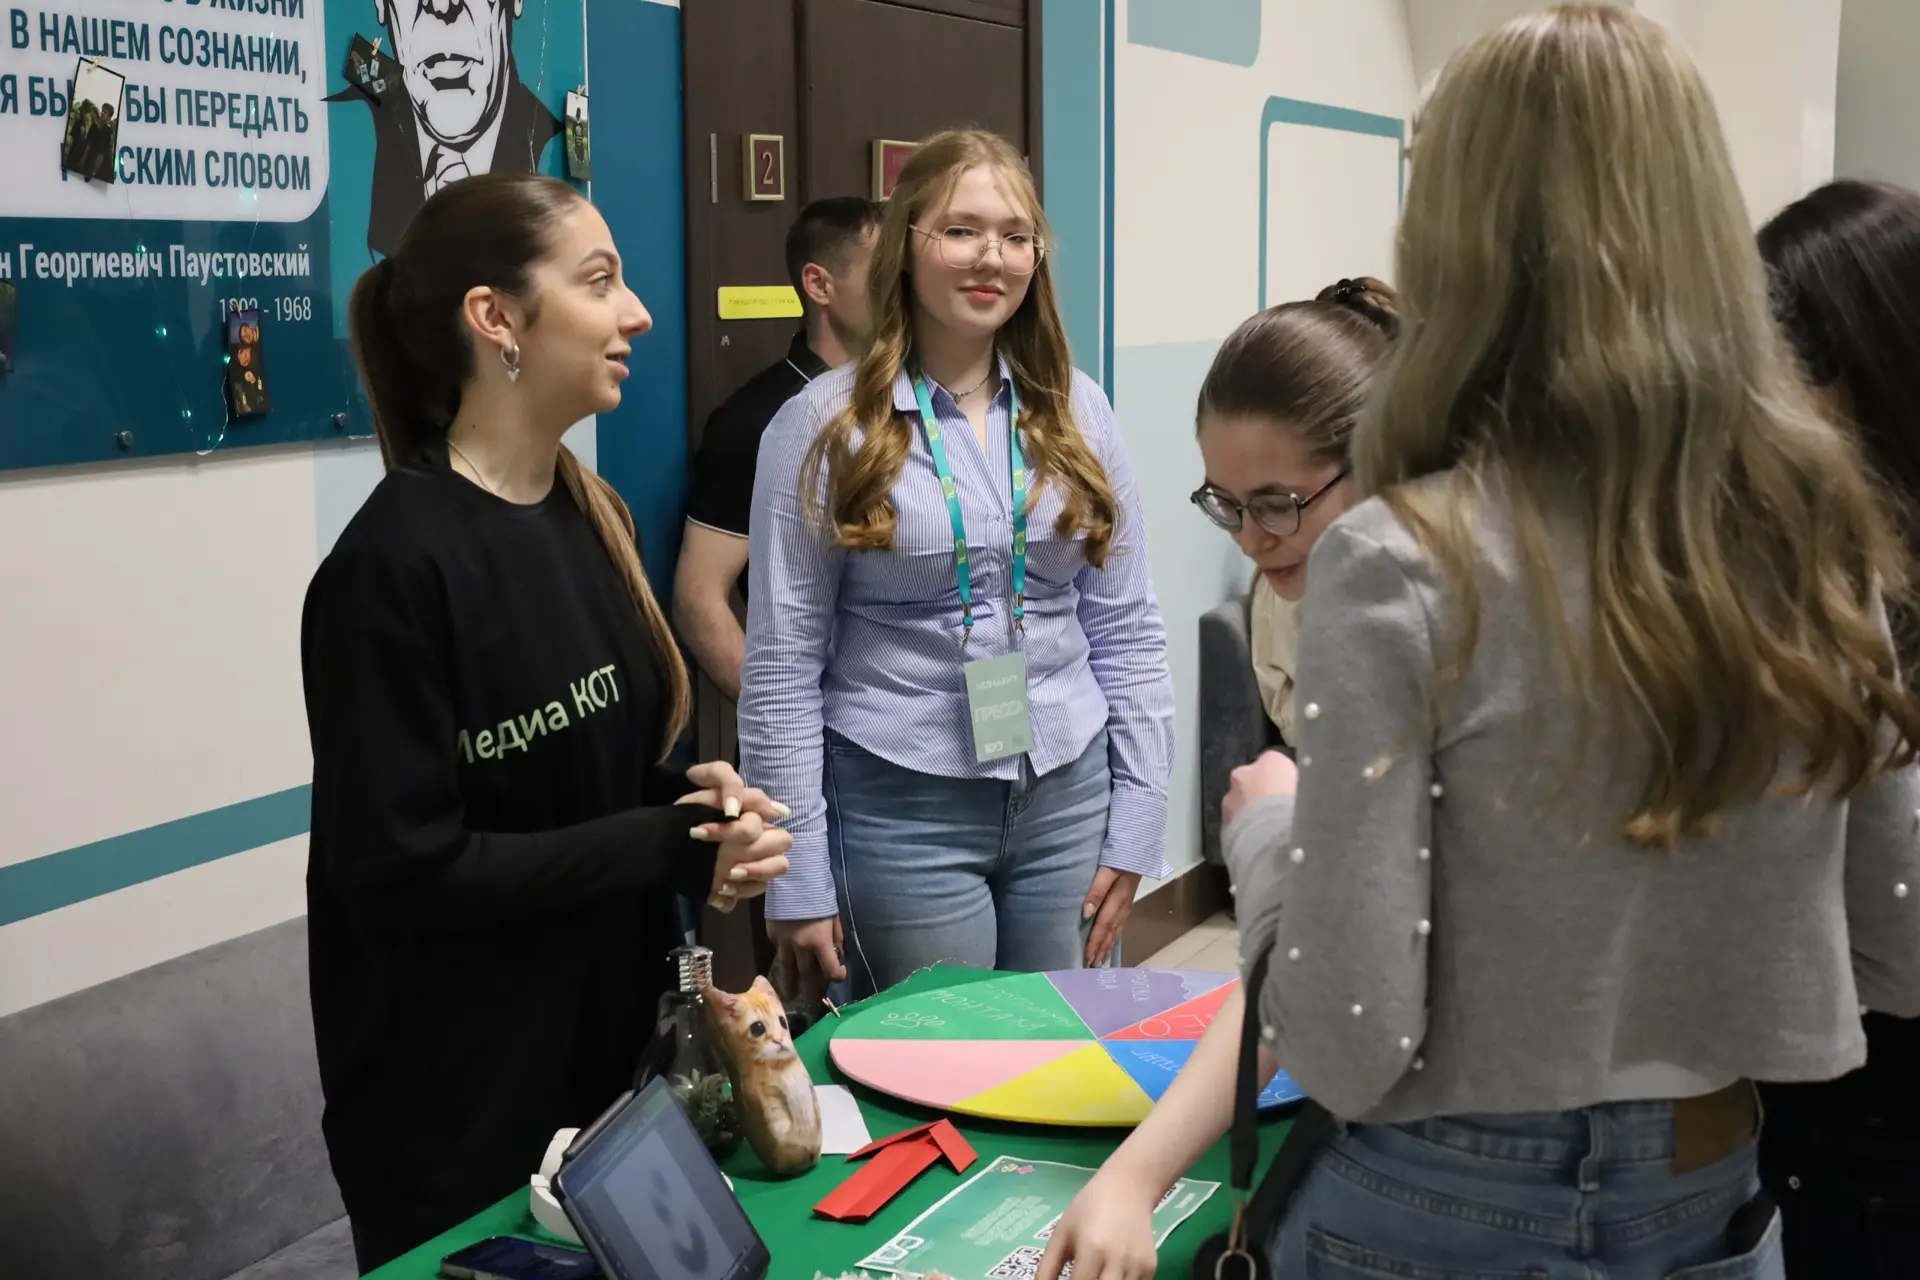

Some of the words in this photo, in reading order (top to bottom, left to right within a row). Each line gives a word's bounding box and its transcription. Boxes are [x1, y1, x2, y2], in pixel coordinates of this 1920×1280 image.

[10, 9, 30, 49] В
[39, 12, 150, 61] НАШЕМ
[159, 25, 307, 84] СОЗНАНИИ,
[28, 75, 74, 117] БЫ
[125, 84, 167, 124] БЫ
[175, 88, 309, 139] ПЕРЕДАТЬ
[60, 142, 196, 187] СКИМ
[204, 150, 311, 191] СЛОВОМ
[761, 151, 774, 185] 2
[19, 243, 162, 288] Георгиевич
[169, 243, 310, 286] Паустовский
[274, 296, 312, 322] 1968
[570, 663, 619, 719] КОТ
